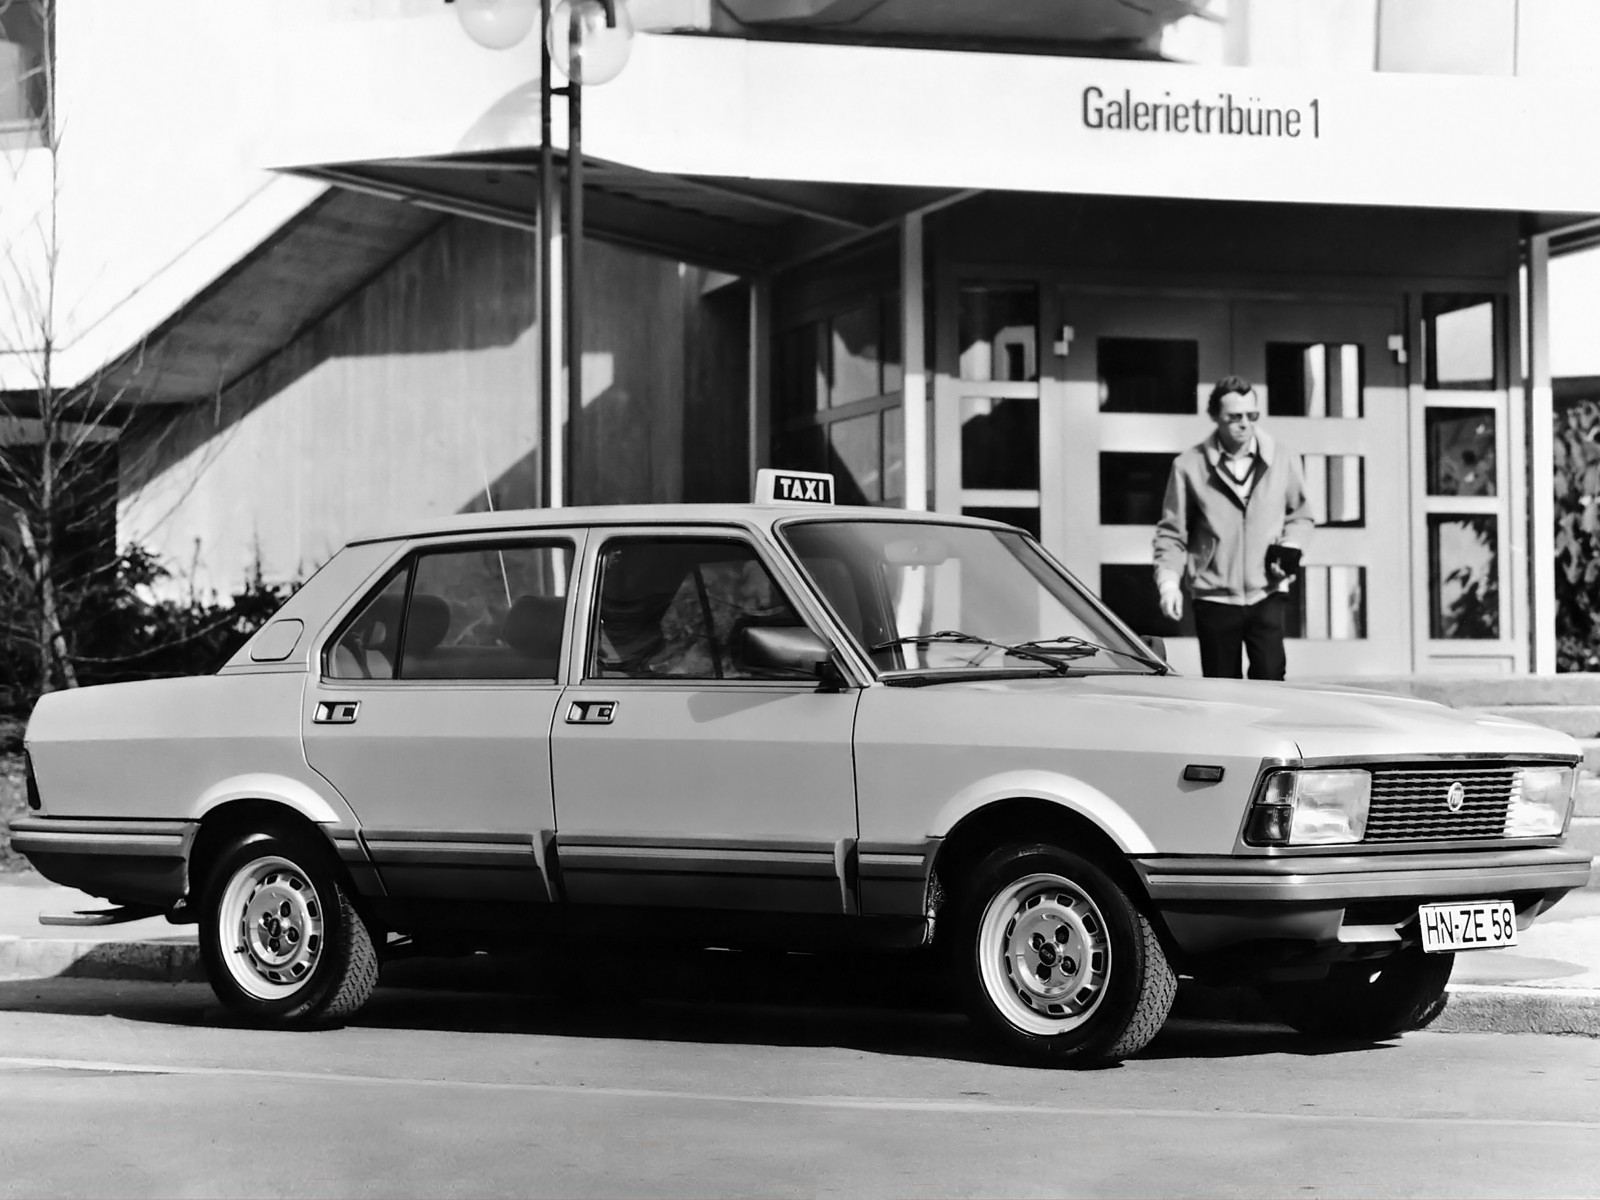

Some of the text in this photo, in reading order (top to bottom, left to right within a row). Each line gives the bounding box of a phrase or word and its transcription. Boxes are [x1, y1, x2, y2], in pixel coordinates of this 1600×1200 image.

[1082, 86, 1320, 139] Galerietribüne 1
[780, 478, 824, 501] TAXI
[1491, 908, 1513, 941] 58
